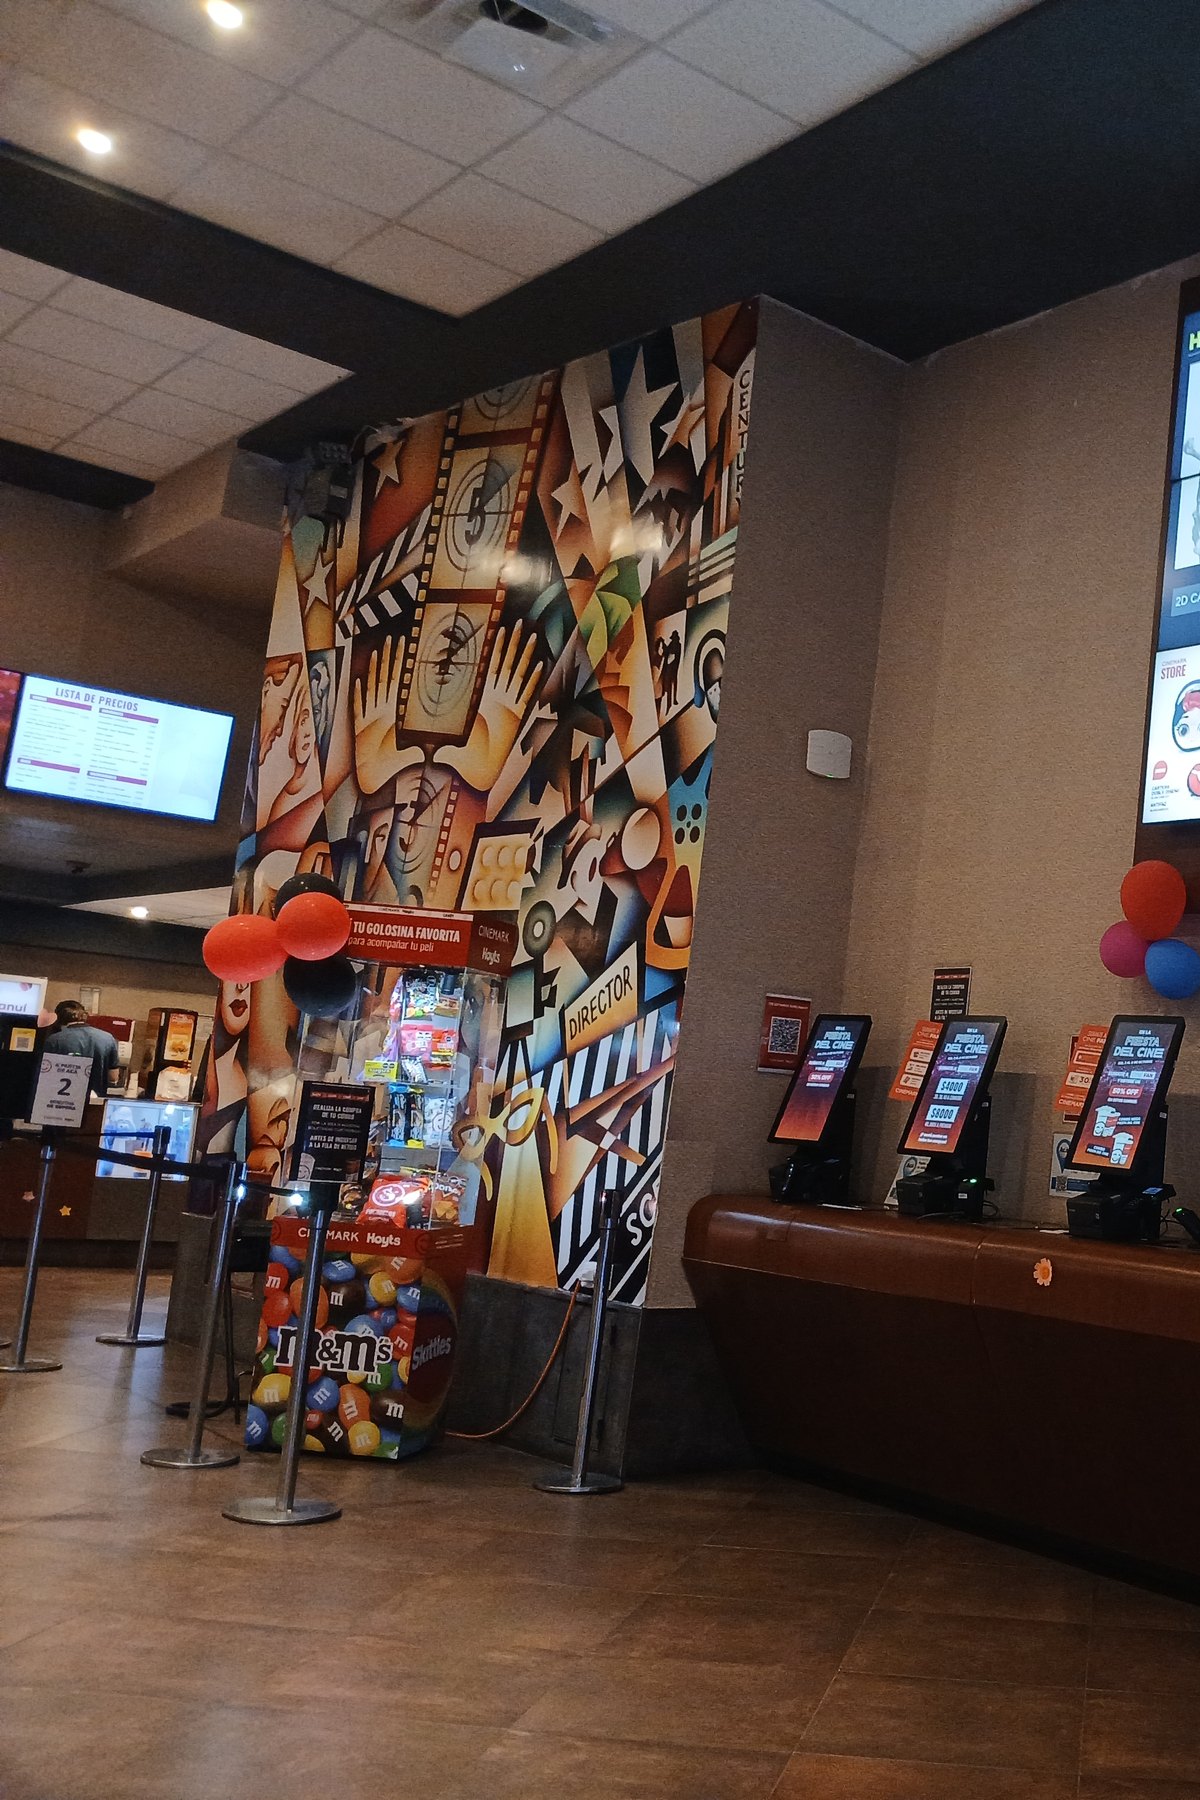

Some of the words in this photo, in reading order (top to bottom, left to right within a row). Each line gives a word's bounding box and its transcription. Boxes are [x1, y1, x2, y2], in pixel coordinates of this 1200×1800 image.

[1175, 595, 1189, 608] 2D
[1161, 664, 1187, 680] STORE
[55, 687, 82, 701] LISTA
[84, 692, 96, 703] DE
[98, 696, 139, 712] PRECIOS
[353, 921, 365, 934] TU
[366, 922, 414, 939] GOLOSINA
[415, 928, 461, 943] FAVORITA
[478, 925, 510, 944] CINEMARK
[347, 937, 365, 946] para
[366, 938, 408, 950] acompañar
[410, 941, 419, 951] tu
[419, 943, 434, 953] peli
[569, 965, 633, 1040] DIRECTOR
[944, 1044, 962, 1053] DEL
[1113, 1046, 1134, 1057] DEL
[1136, 1047, 1165, 1059] CINE
[57, 1077, 72, 1096] 2
[941, 1081, 964, 1092] $4000
[297, 1228, 360, 1243] CIMARK
[366, 1232, 401, 1248] Hoyts
[412, 1336, 452, 1370] Skittles
